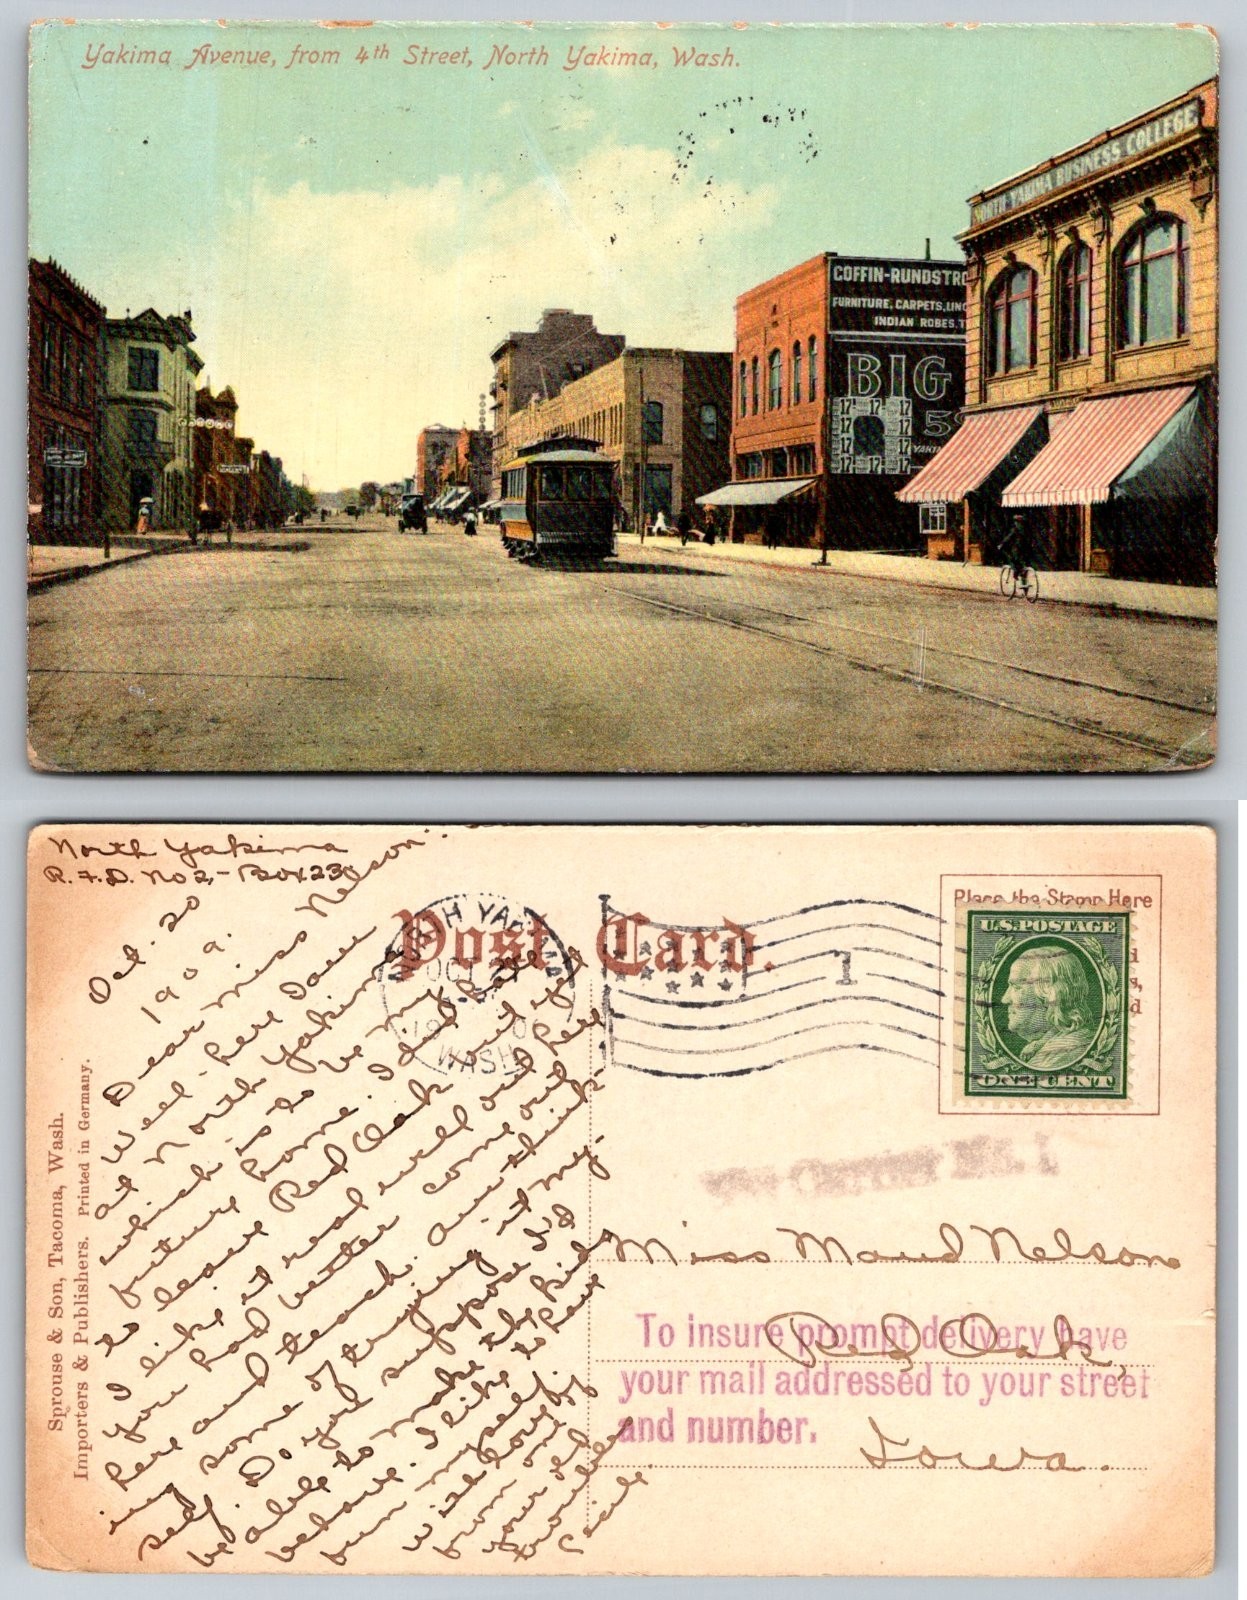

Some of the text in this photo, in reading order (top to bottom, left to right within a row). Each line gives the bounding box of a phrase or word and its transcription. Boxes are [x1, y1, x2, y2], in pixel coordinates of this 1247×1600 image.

[82, 43, 741, 71] Yakima Avenue, from 4th Street, North Yakima, Wash.
[1057, 141, 1121, 185] BUSINESS
[832, 297, 893, 309] FURNITURE,
[874, 316, 914, 327] INDIAN
[840, 399, 852, 415] 17
[870, 399, 881, 415] 17
[899, 399, 911, 415] 17
[847, 352, 952, 401] BIG
[840, 416, 911, 434] 17 17
[840, 436, 911, 454] 17 17
[840, 456, 852, 472] 17
[869, 456, 881, 473] 17
[899, 457, 911, 473] 17
[48, 834, 349, 869] North Yakima
[158, 895, 200, 933] 20
[1109, 889, 1153, 907] Here
[391, 909, 551, 983] Post
[596, 911, 775, 976] Card.
[102, 1020, 205, 1108] Dear
[203, 1010, 284, 1067] here
[94, 1174, 141, 1221] at
[143, 1077, 267, 1165] North
[261, 948, 405, 1073] Yakima
[977, 1074, 1115, 1090] ONE CENT
[99, 1044, 364, 1267] which is to be
[93, 1321, 140, 1358] to
[153, 1220, 270, 1313] leave
[268, 1143, 349, 1213] Red
[352, 1078, 454, 1153] Oak
[105, 1382, 132, 1402] I
[139, 1307, 224, 1378] like
[240, 1264, 274, 1306] it
[281, 1186, 369, 1270] real
[377, 1104, 474, 1197] well
[479, 1047, 537, 1112] out
[605, 1221, 1182, 1270] Miss Maud Nelson
[47, 1111, 70, 1431] Sprouse & Son, Tacoma, Wash.
[73, 1058, 94, 1481] Importers & Publishers. Printed in Germany.
[101, 1060, 572, 1444] you had better come out
[108, 1195, 241, 1310] future
[98, 1482, 197, 1536] ing
[199, 1400, 304, 1476] some
[304, 1359, 359, 1403] of
[340, 1248, 499, 1369] trying
[480, 1187, 532, 1237] it
[414, 1426, 439, 1450] I
[440, 1369, 510, 1429] like
[510, 1337, 547, 1361] to
[537, 1273, 606, 1335] have
[635, 1313, 1128, 1359] To insure prompt delivery have
[764, 1311, 921, 1373] Red
[618, 1360, 1150, 1407] your mail addressed to your street
[104, 1436, 183, 1492] here
[191, 1351, 270, 1435] and
[186, 1542, 234, 1568] be
[244, 1475, 332, 1545] able
[332, 1445, 375, 1472] to
[369, 1359, 485, 1441] make
[478, 1307, 539, 1352] the
[238, 1447, 293, 1488] Do
[300, 1397, 374, 1450] you
[617, 1407, 817, 1444] and number.
[319, 1500, 408, 1567] fun
[401, 1470, 488, 1552] with
[432, 1479, 534, 1560] from
[481, 1486, 548, 1554] your
